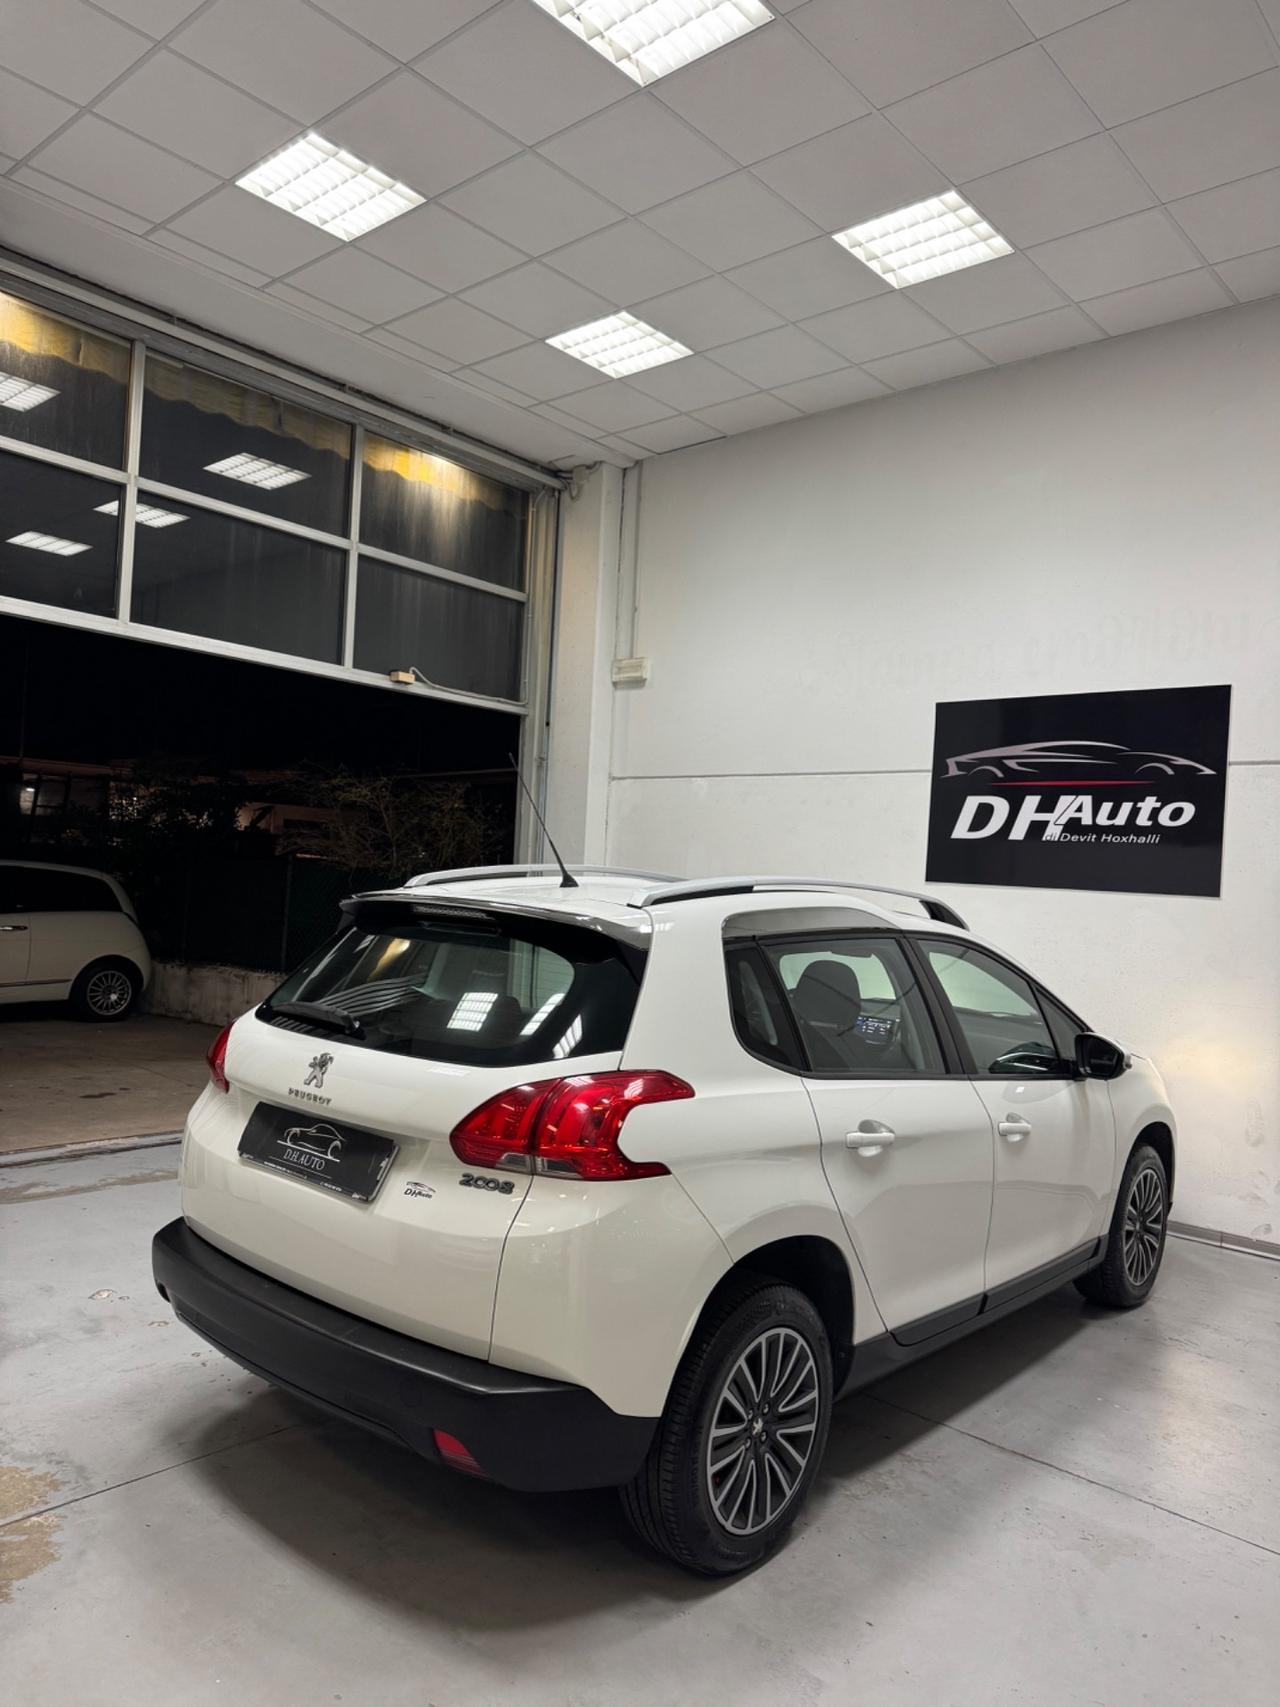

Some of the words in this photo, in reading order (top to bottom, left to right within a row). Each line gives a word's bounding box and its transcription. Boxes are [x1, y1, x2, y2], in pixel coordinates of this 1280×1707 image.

[1060, 832, 1097, 843] Devit
[1101, 833, 1161, 844] Hoxhalli
[288, 1087, 332, 1106] PEUGEOT
[459, 1172, 516, 1195] 2008
